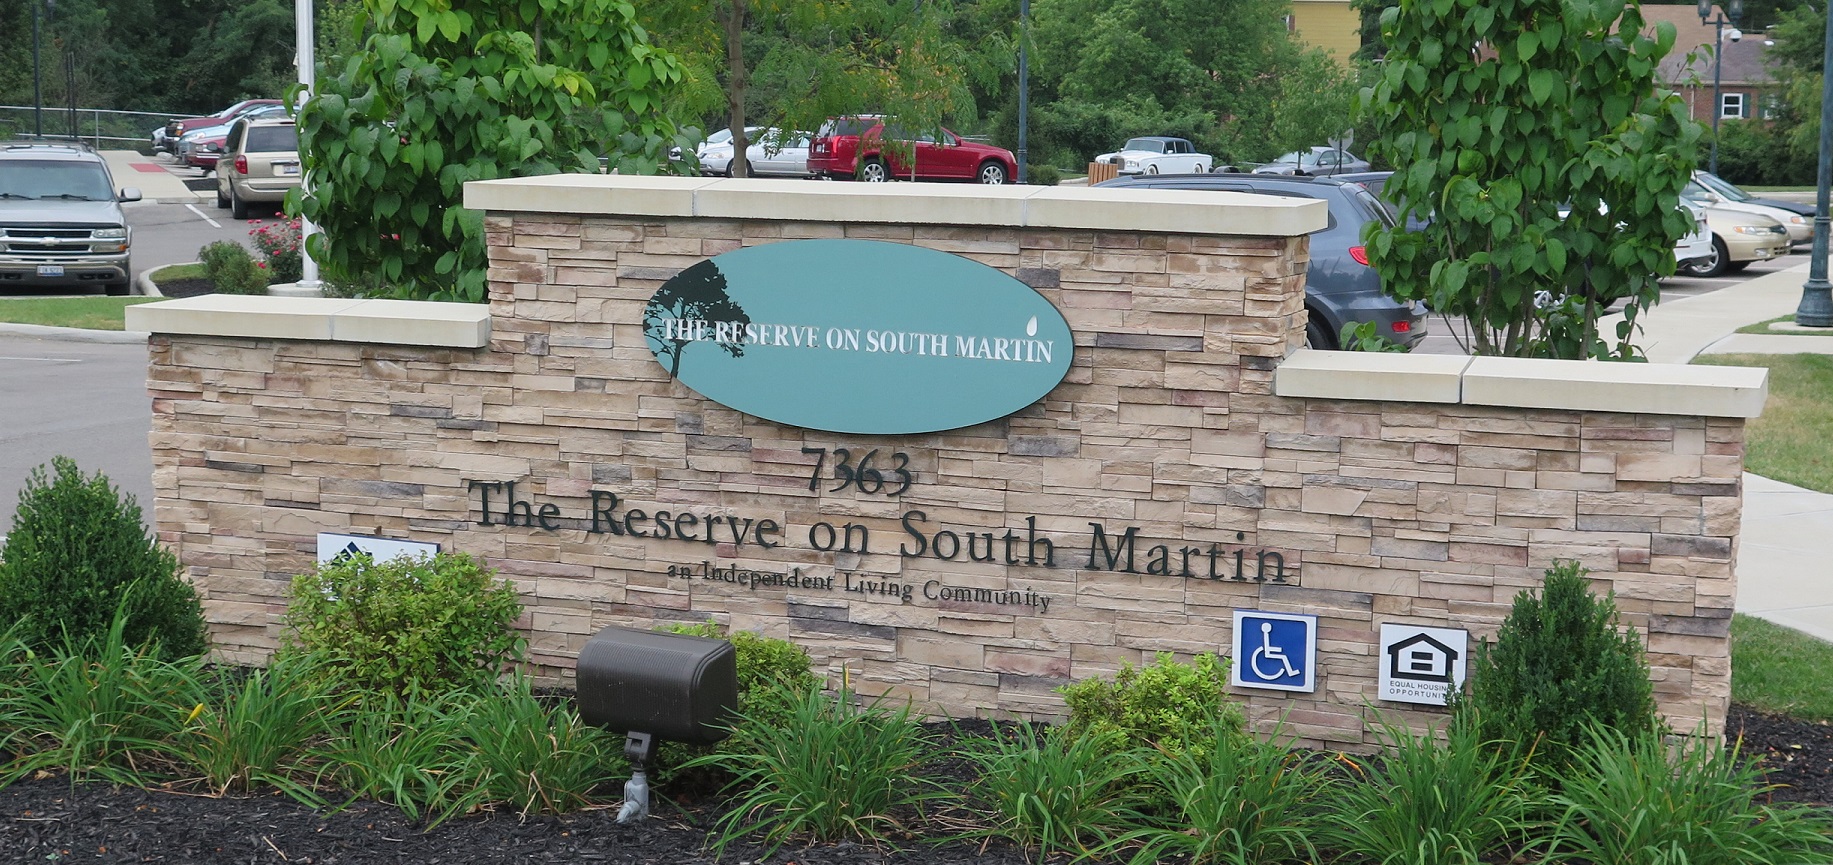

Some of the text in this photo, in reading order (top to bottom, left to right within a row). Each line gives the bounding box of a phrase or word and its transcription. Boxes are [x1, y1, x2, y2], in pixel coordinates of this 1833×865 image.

[662, 317, 1054, 364] THE RESERVE ON SOUTH MARTIN
[801, 446, 912, 497] 7363
[468, 480, 1288, 583] The Reserve on South Martin
[667, 560, 1051, 614] an Independent Living Community
[1390, 680, 1450, 692] EQUAL HOUSIN
